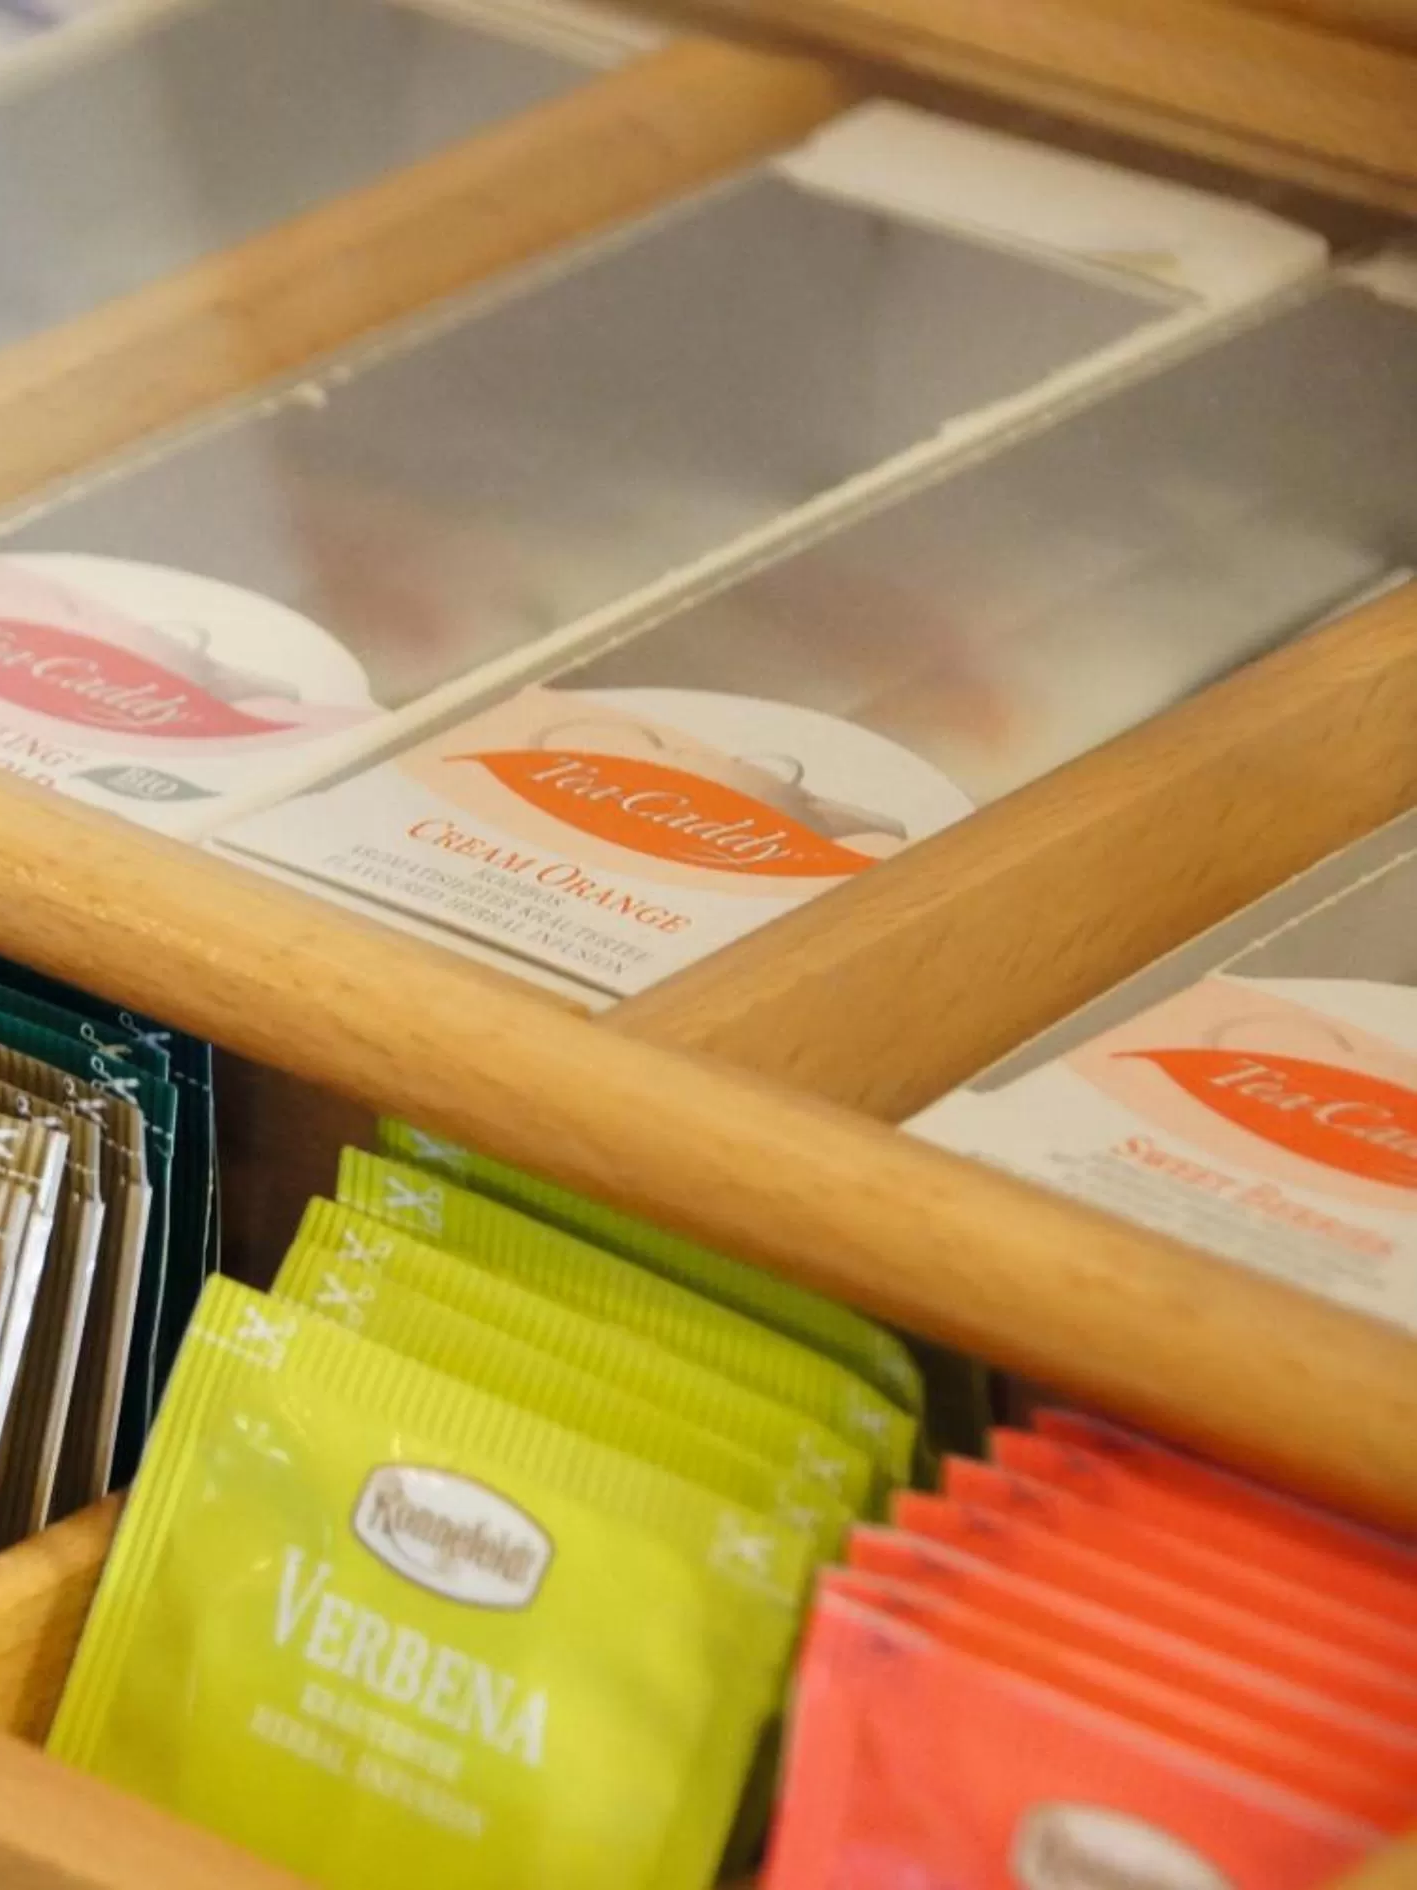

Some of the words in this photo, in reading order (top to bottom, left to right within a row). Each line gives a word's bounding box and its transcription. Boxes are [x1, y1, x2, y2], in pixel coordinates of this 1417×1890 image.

[530, 756, 791, 864] Tea-Caddy
[406, 818, 536, 874] CREAM
[535, 862, 692, 934] ORANGE
[273, 1543, 550, 1768] VERBENA
